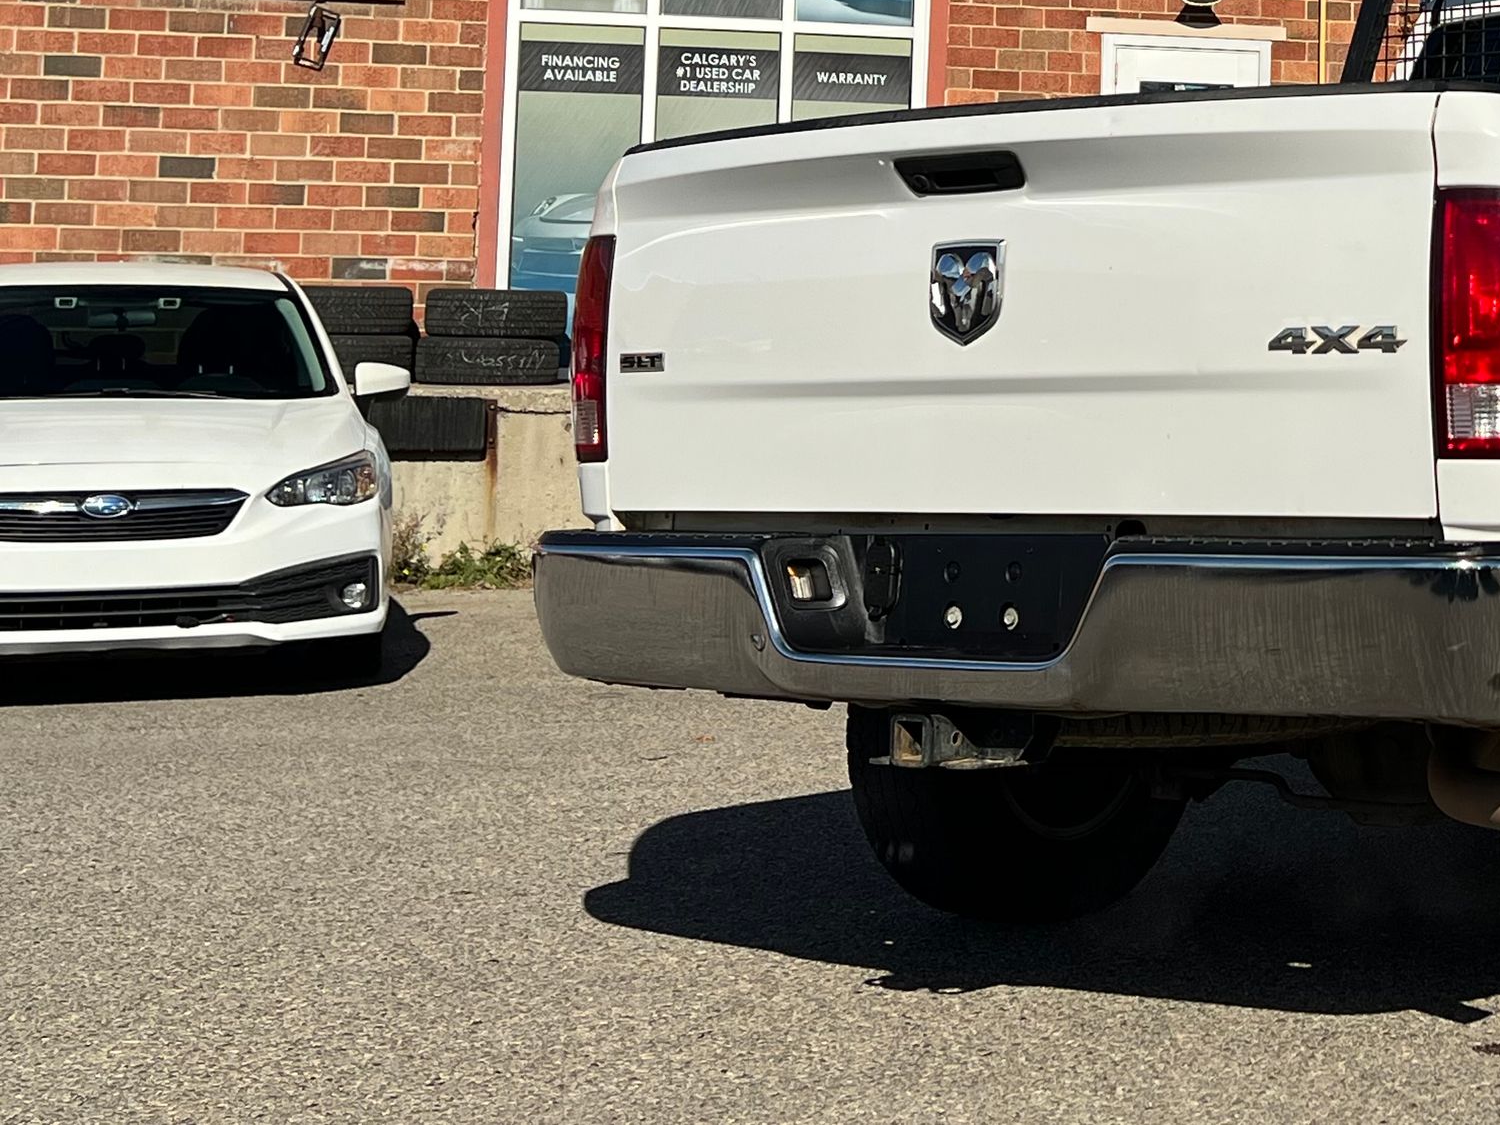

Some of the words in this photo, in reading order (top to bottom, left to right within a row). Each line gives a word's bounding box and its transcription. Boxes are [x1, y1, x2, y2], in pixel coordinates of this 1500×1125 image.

[541, 54, 620, 69] FINANCING
[681, 53, 757, 66] CALGARY'S
[543, 69, 617, 82] AVAILABLE
[676, 66, 691, 78] #1
[695, 67, 728, 78] USED
[732, 68, 760, 80] CAR
[816, 71, 887, 85] WARRANTY
[680, 80, 755, 93] DEALERSHIP
[1268, 325, 1408, 354] 4X4
[620, 354, 663, 370] SLT
